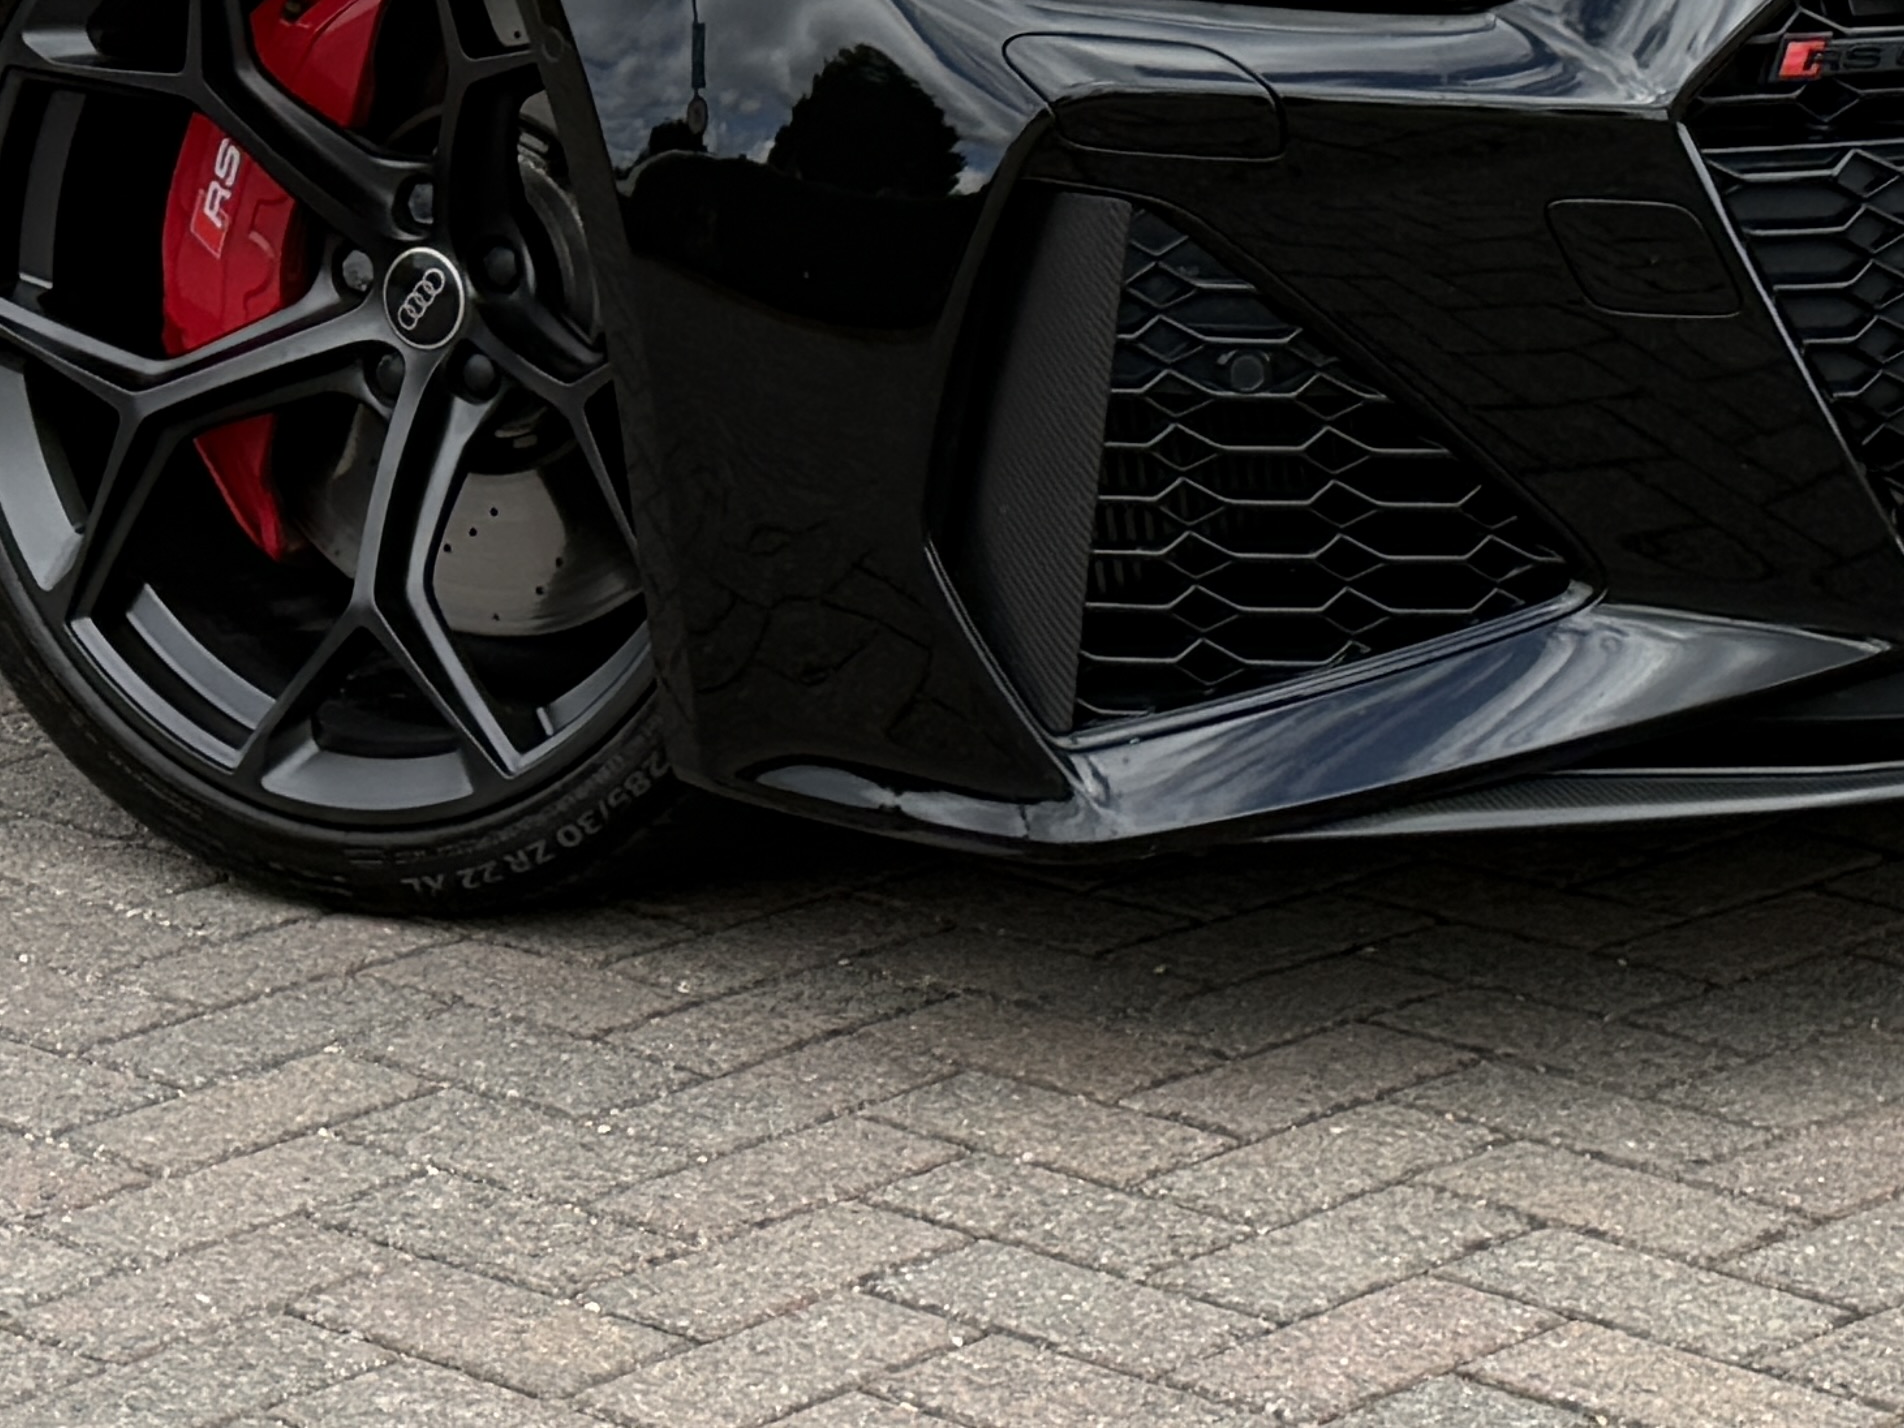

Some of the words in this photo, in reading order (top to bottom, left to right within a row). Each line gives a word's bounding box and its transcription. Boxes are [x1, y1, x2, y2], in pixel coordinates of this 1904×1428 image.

[1802, 46, 1882, 71] RS
[203, 138, 242, 229] RS
[557, 748, 671, 849] 285/30
[504, 838, 556, 874] ZR
[457, 859, 503, 891] 22
